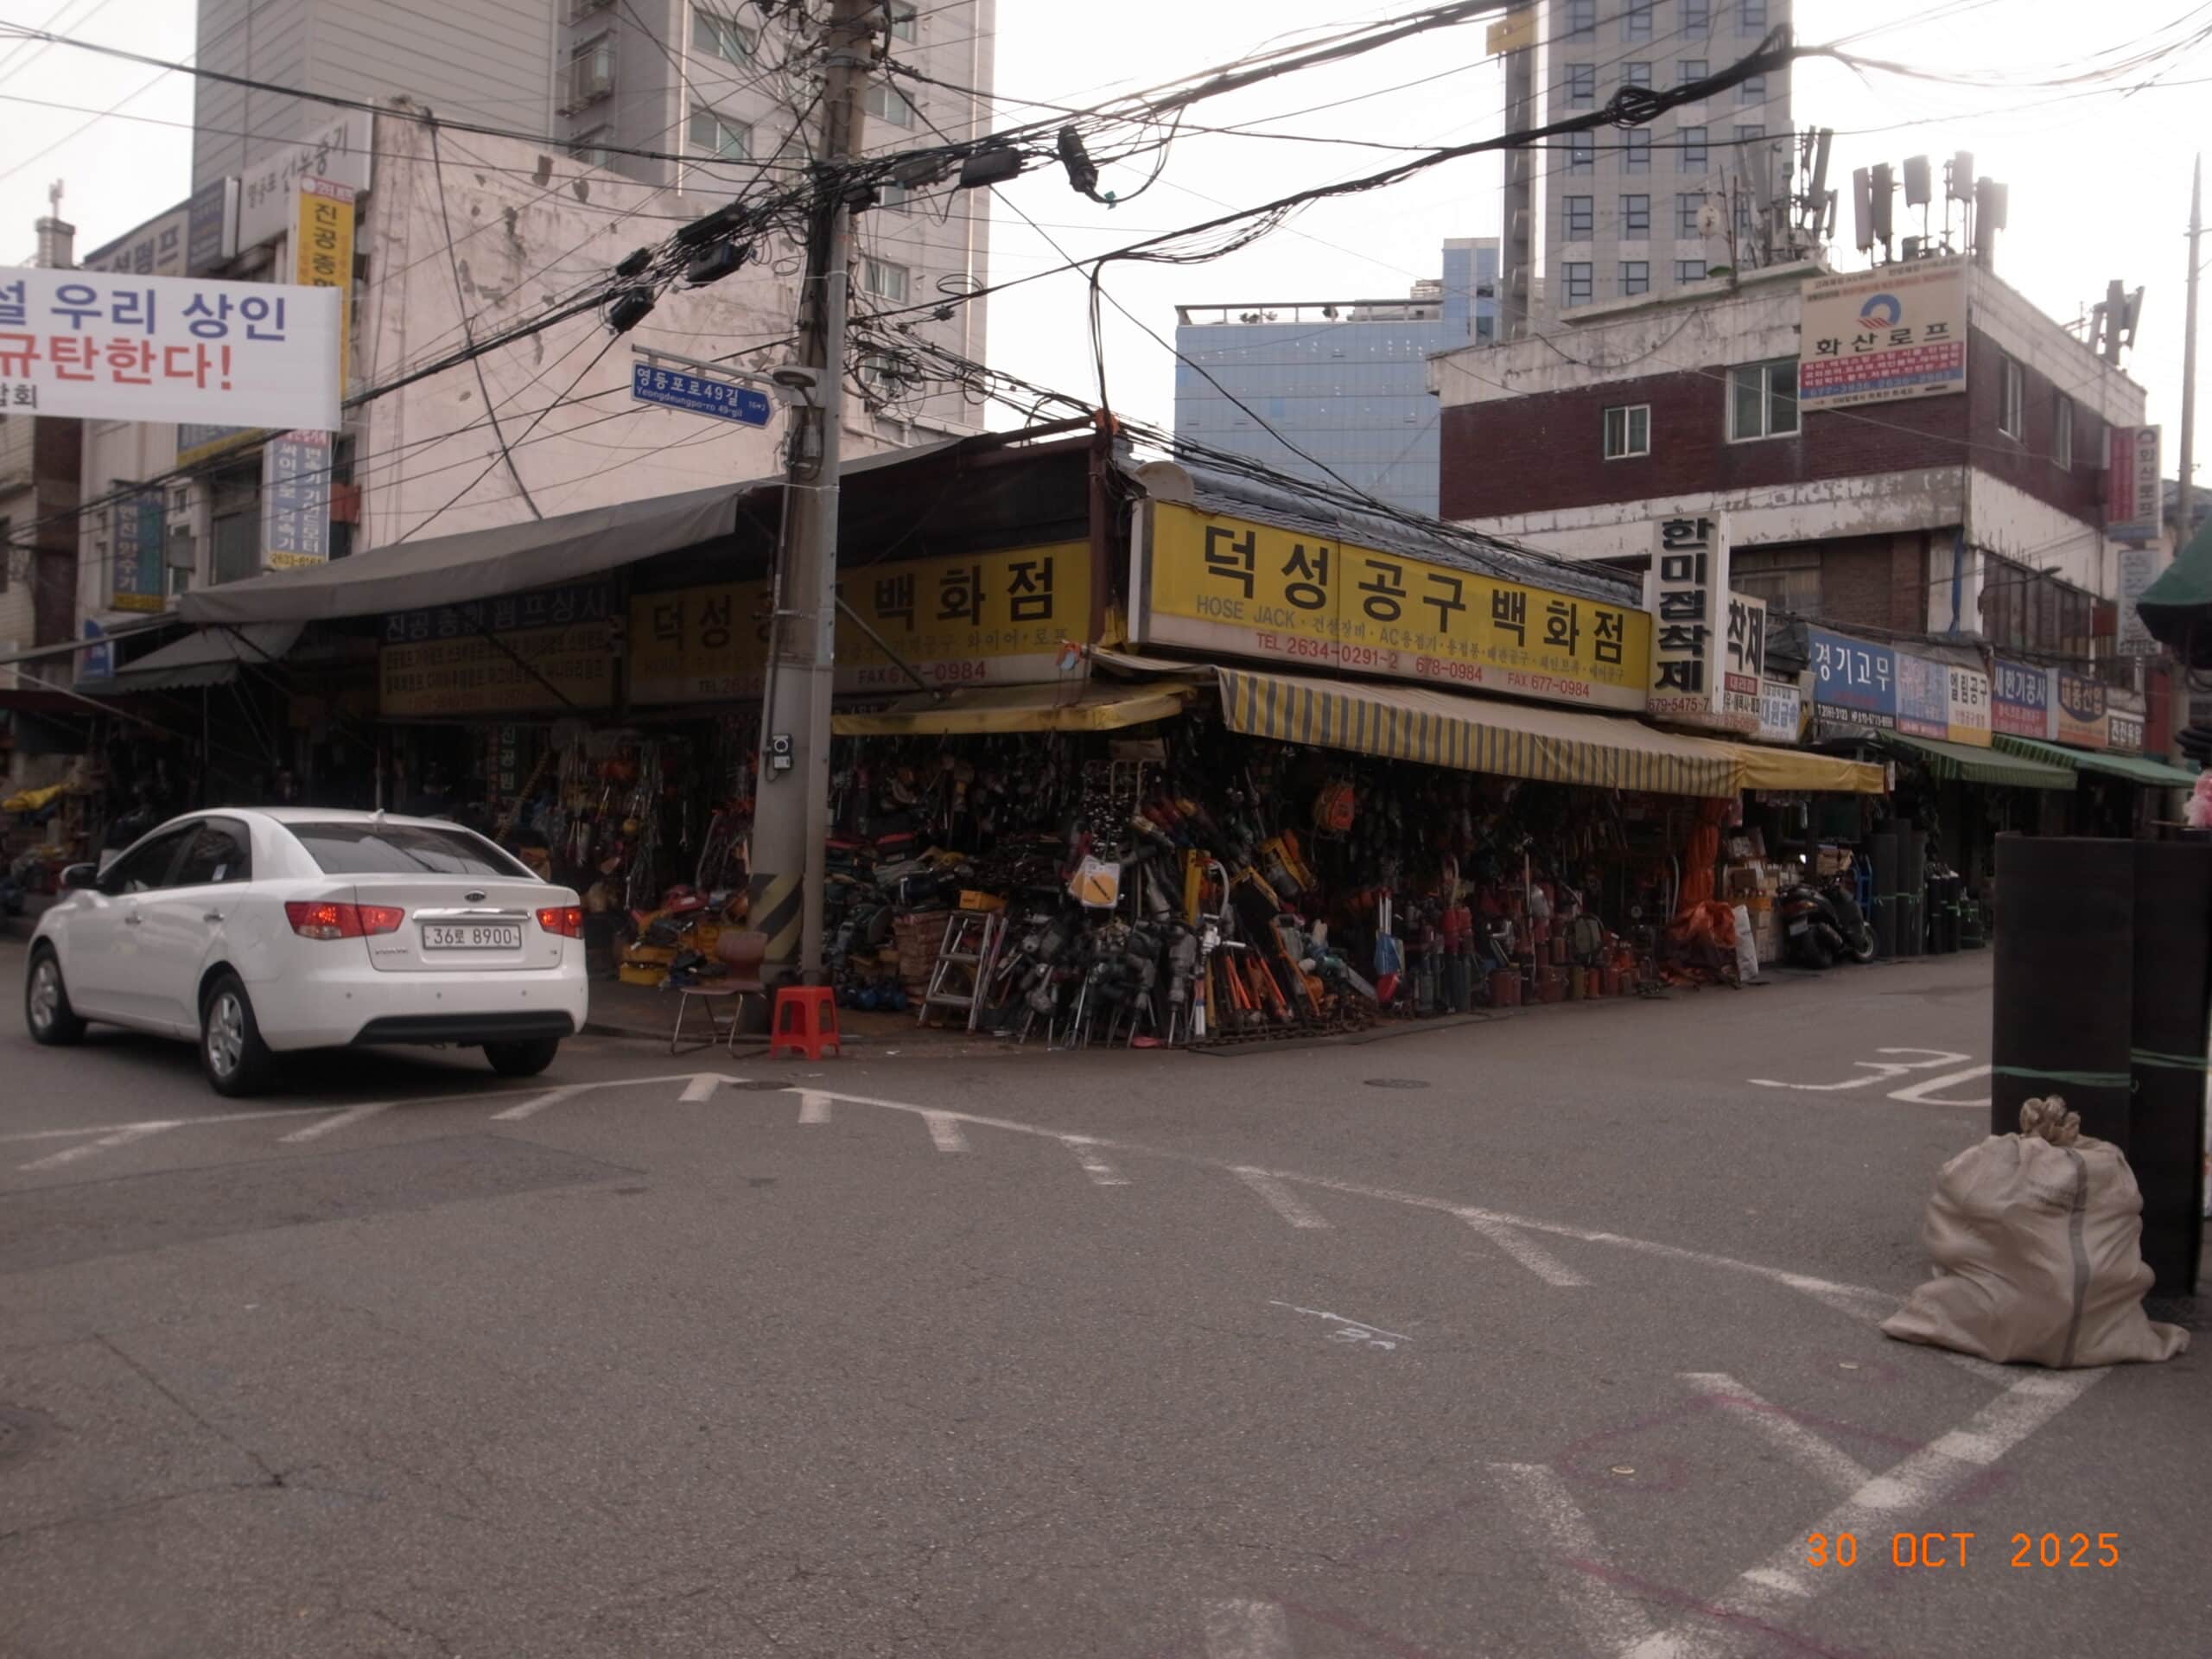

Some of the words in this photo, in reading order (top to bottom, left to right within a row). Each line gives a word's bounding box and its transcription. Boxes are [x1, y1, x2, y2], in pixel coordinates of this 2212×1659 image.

[50, 283, 156, 334] 우리
[182, 293, 285, 341] 상인
[1815, 322, 1949, 356] 화산로프
[0, 332, 232, 391] 규탄한다!
[636, 385, 716, 411] Yeongdeungpo-ro
[637, 367, 739, 407] 영등포로49길
[1196, 594, 1245, 620] HOSE
[1254, 605, 1295, 629] JACK
[1205, 524, 1624, 665] 덕성공구백화점
[1655, 517, 1716, 694] 한미접착제
[858, 668, 886, 684] FAX
[1256, 632, 1281, 651] TEL
[1287, 636, 1398, 670] 2634-0291-2
[1415, 658, 1483, 682] 678-0984
[1507, 672, 1529, 687] FAX
[1531, 675, 1591, 697] 677-0984
[1815, 642, 1891, 691] 경기고무
[473, 928, 512, 944] 8900
